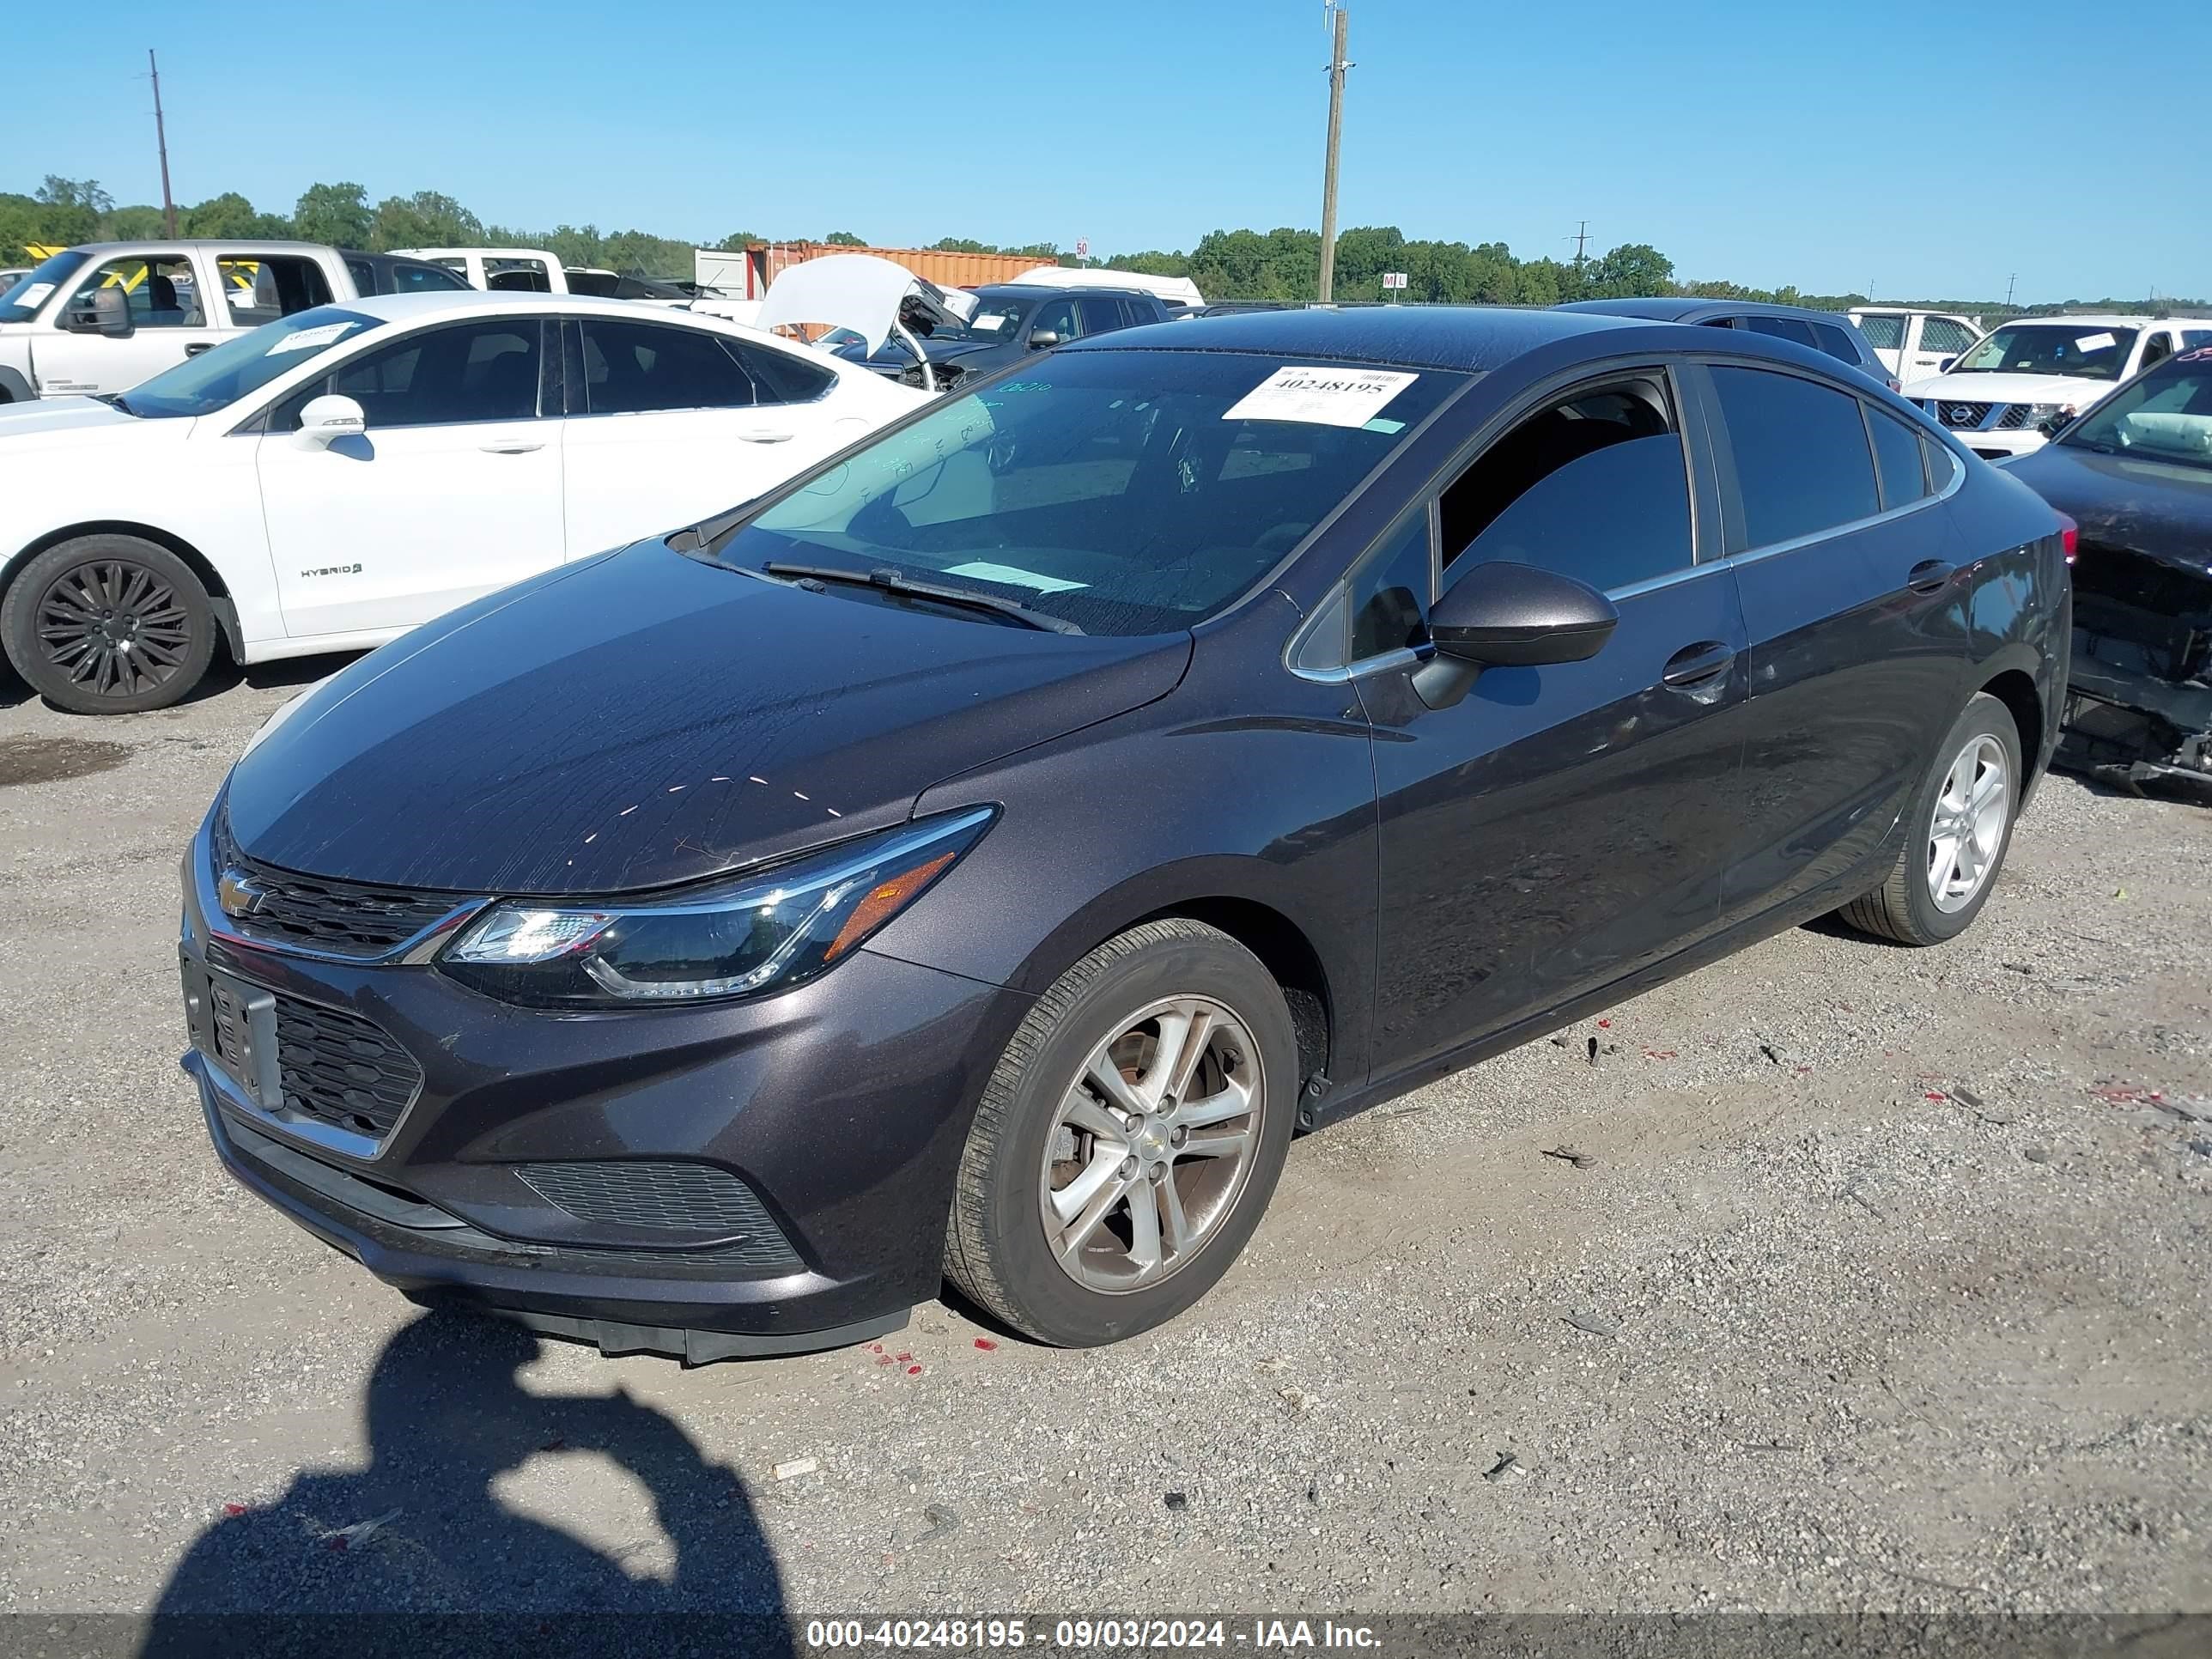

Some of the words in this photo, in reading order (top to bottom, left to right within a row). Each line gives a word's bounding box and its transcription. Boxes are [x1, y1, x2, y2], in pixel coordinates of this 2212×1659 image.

[1077, 242, 1087, 255] 50
[1384, 276, 1394, 286] M
[1399, 276, 1405, 286] L
[1274, 379, 1389, 395] 40248195
[301, 565, 351, 578] HYBRID
